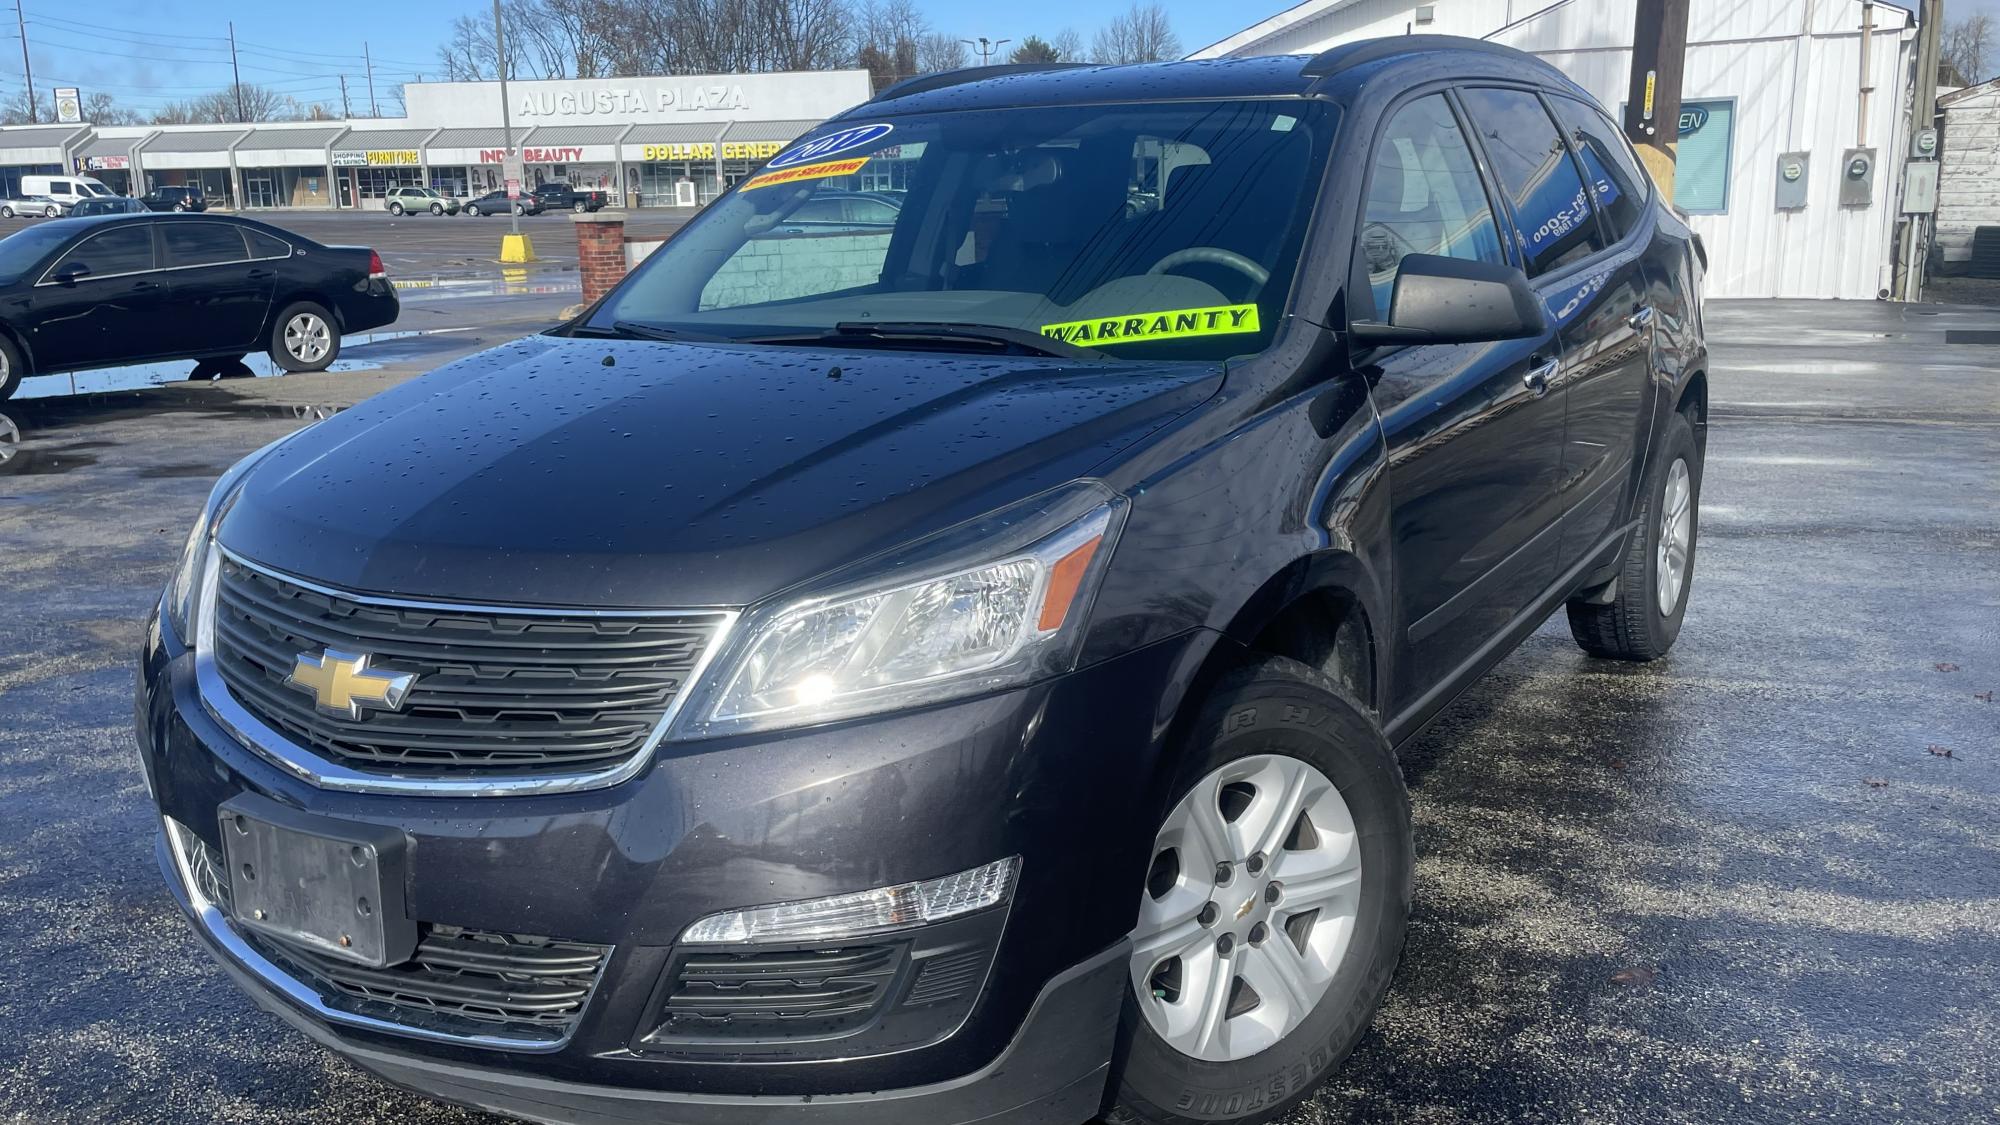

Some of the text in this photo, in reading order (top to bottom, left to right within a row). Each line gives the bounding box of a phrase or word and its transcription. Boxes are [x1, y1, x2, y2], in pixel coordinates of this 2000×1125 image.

[519, 85, 749, 116] AUGUSTA PLAZA
[1677, 111, 1704, 130] EN
[643, 142, 779, 160] DOLLAR GENER
[782, 127, 877, 163] 2017
[333, 152, 365, 160] SHOPPING
[368, 151, 419, 164] FURNITURE
[524, 147, 583, 162] BEAUTY
[798, 161, 863, 177] SEATING
[1044, 308, 1251, 342] WARRANTY
